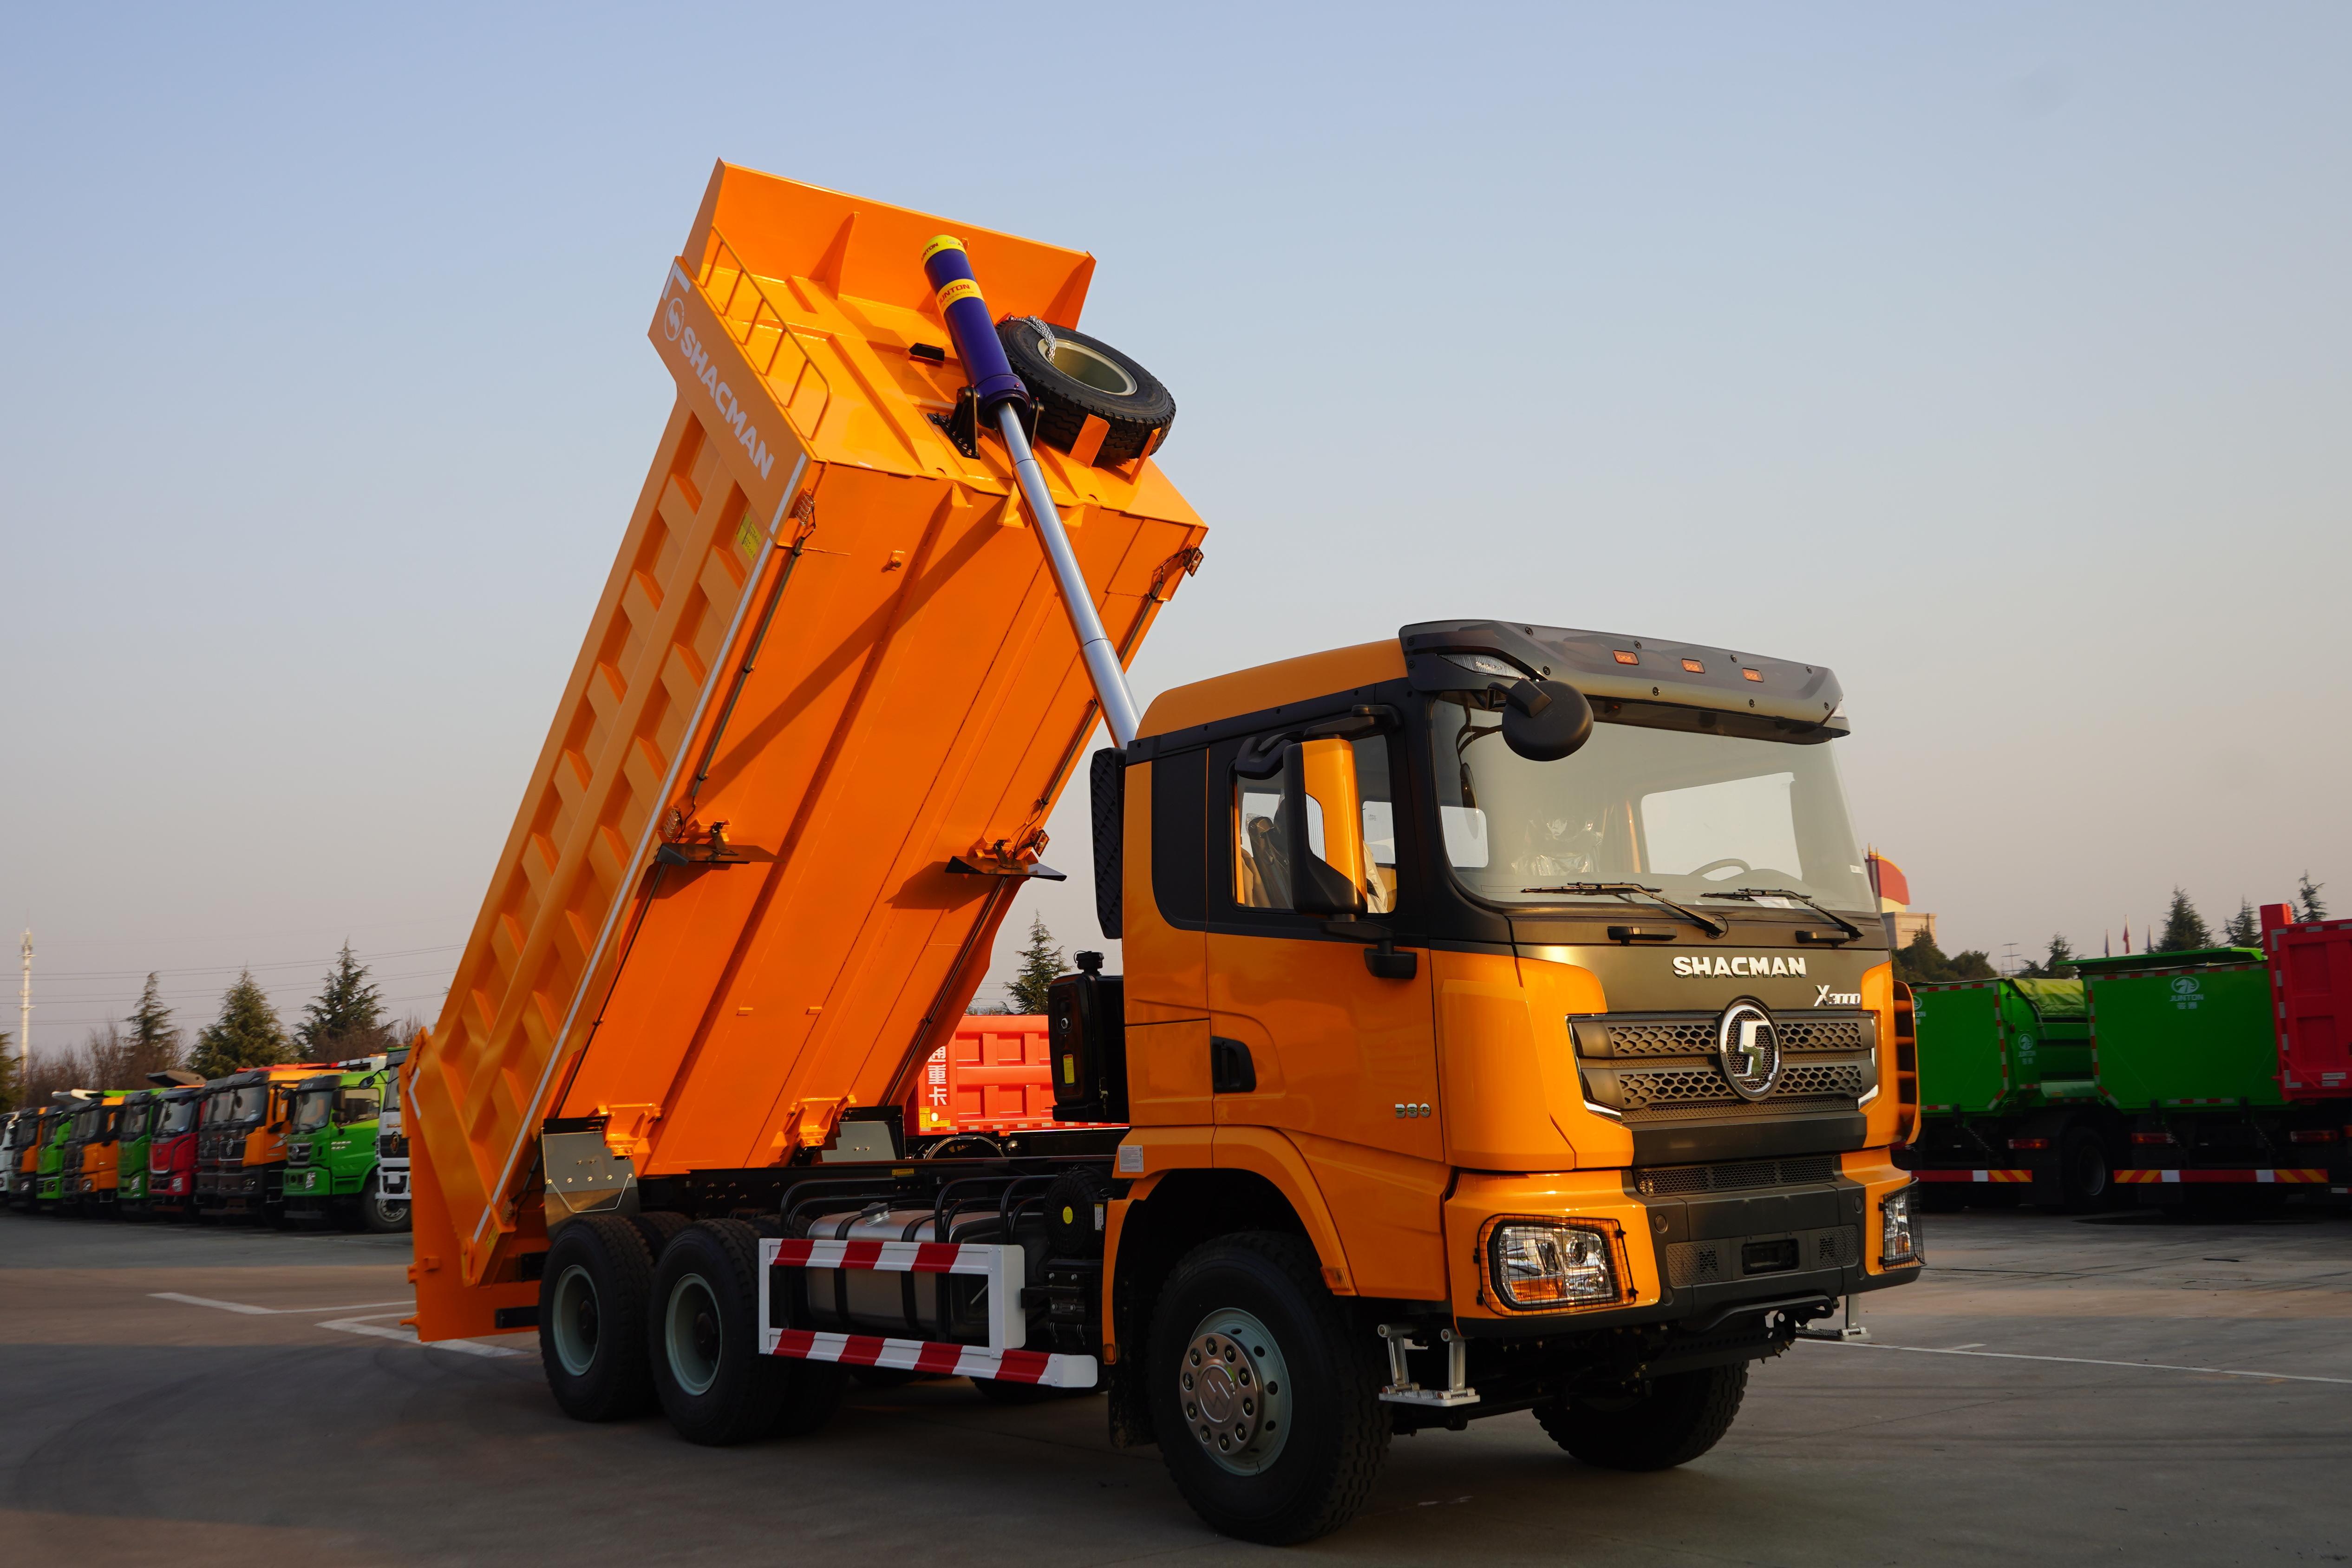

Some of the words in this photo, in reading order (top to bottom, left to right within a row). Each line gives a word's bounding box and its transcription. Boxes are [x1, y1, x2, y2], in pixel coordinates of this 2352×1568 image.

[921, 242, 939, 261] UNTON
[680, 326, 775, 481] SHACMAN
[1673, 956, 1807, 978] SHACMAN
[1813, 985, 1861, 1007] X3000
[1395, 1103, 1431, 1118] 380
